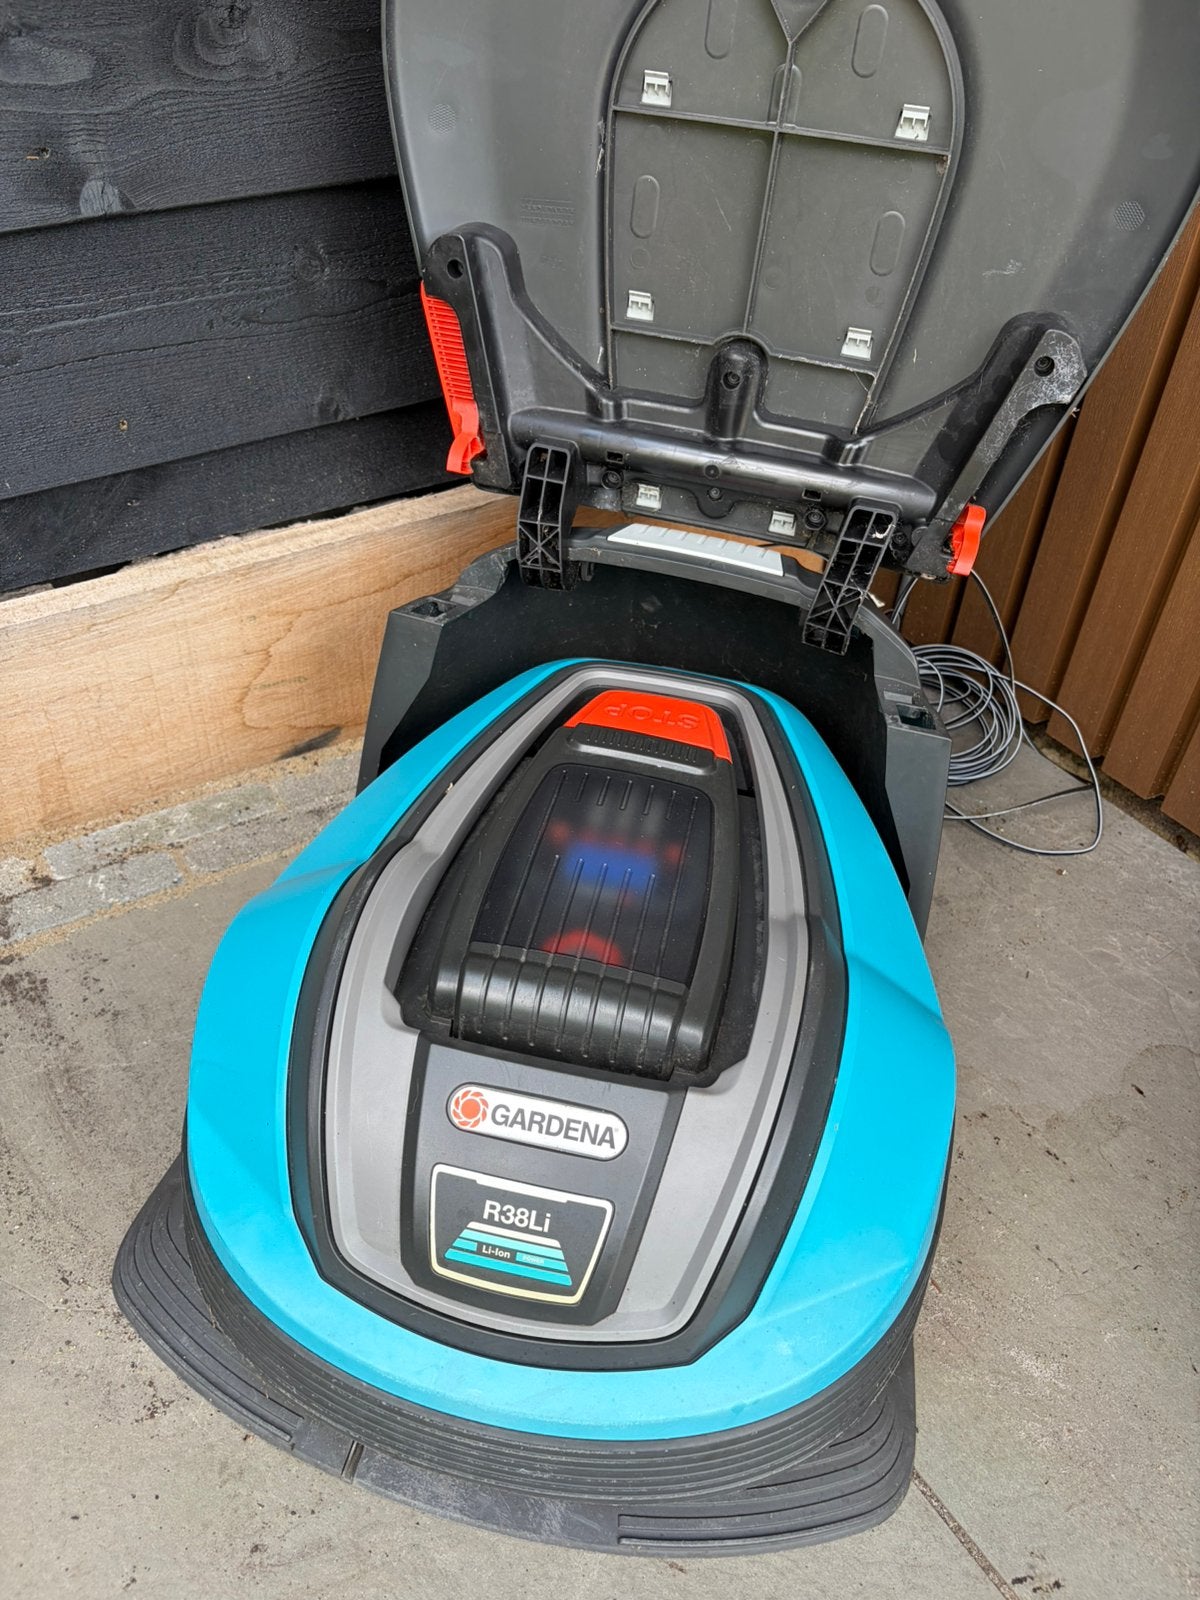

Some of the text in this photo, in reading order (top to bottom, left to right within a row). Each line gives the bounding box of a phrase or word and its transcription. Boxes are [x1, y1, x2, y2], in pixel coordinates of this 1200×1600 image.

[604, 703, 699, 728] STOP
[491, 1104, 615, 1149] GARDENA
[483, 1199, 551, 1232] R38Li
[482, 1244, 511, 1259] Li-Ion
